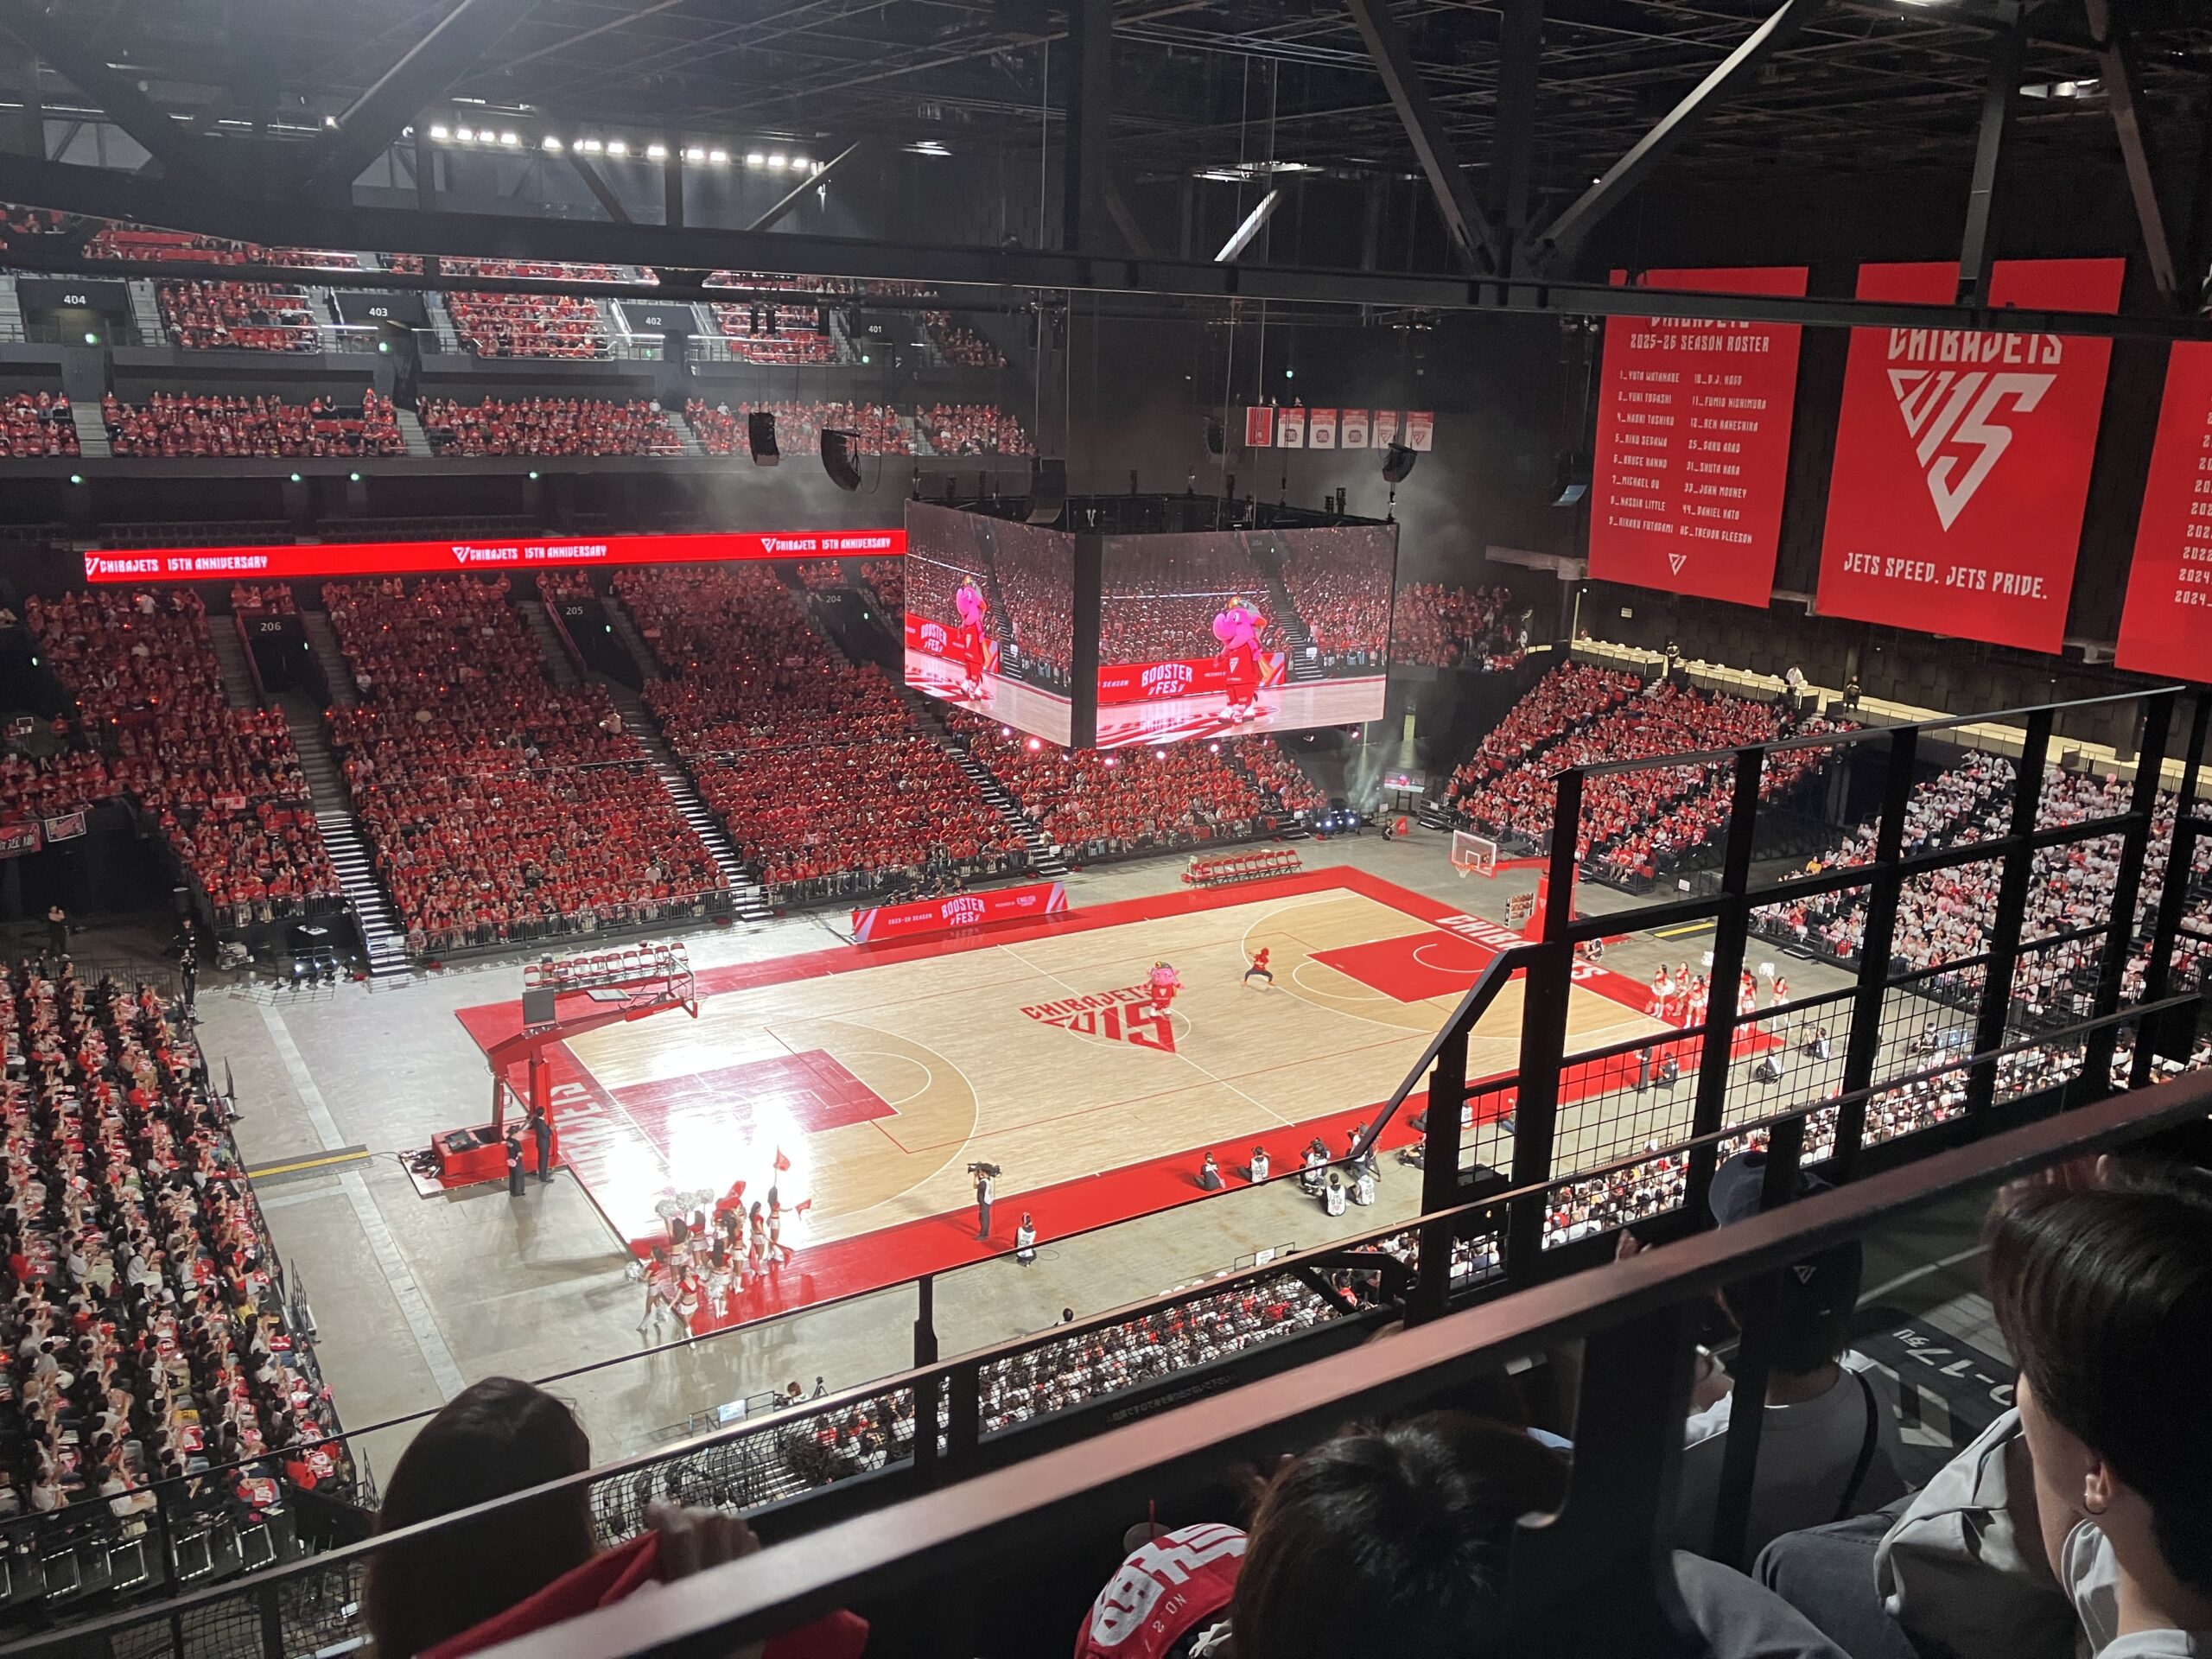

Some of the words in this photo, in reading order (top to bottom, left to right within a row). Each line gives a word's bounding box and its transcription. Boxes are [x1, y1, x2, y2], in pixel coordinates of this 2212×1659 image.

[64, 295, 86, 305] 404
[368, 308, 388, 317] 403
[645, 316, 662, 326] 402
[868, 325, 882, 334] 401
[1630, 334, 1677, 350] 2025-26
[1681, 334, 1723, 352] SEASON
[1727, 335, 1770, 353] ROSTER
[1644, 499, 1666, 512] LITTLE
[776, 539, 817, 551] CHIBAJETS
[822, 538, 839, 550] 15TH
[840, 537, 891, 550] ANNIVERSARY
[470, 548, 518, 561] CHIBAJETS
[524, 547, 545, 559] 15TH
[547, 545, 607, 558] ANNIVERSARY
[99, 559, 159, 573] CHIBAJETS
[167, 557, 193, 571] 15TH
[195, 556, 268, 570] ANNIVERSARY
[1844, 552, 1880, 575] JETS
[1885, 556, 1939, 584] SPEED.
[1946, 566, 1986, 590] JETS
[1992, 571, 2047, 600] PRIDE.
[826, 594, 842, 603] 204
[566, 606, 583, 615] 205
[260, 621, 282, 631] 206
[921, 623, 947, 646] BOOSTER
[927, 638, 940, 652] FES
[1141, 663, 1192, 688] BOOSTER
[1103, 679, 1129, 689] SEASON
[1155, 679, 1177, 695] FES
[941, 897, 986, 919] BOOSTER
[956, 912, 974, 925] FES
